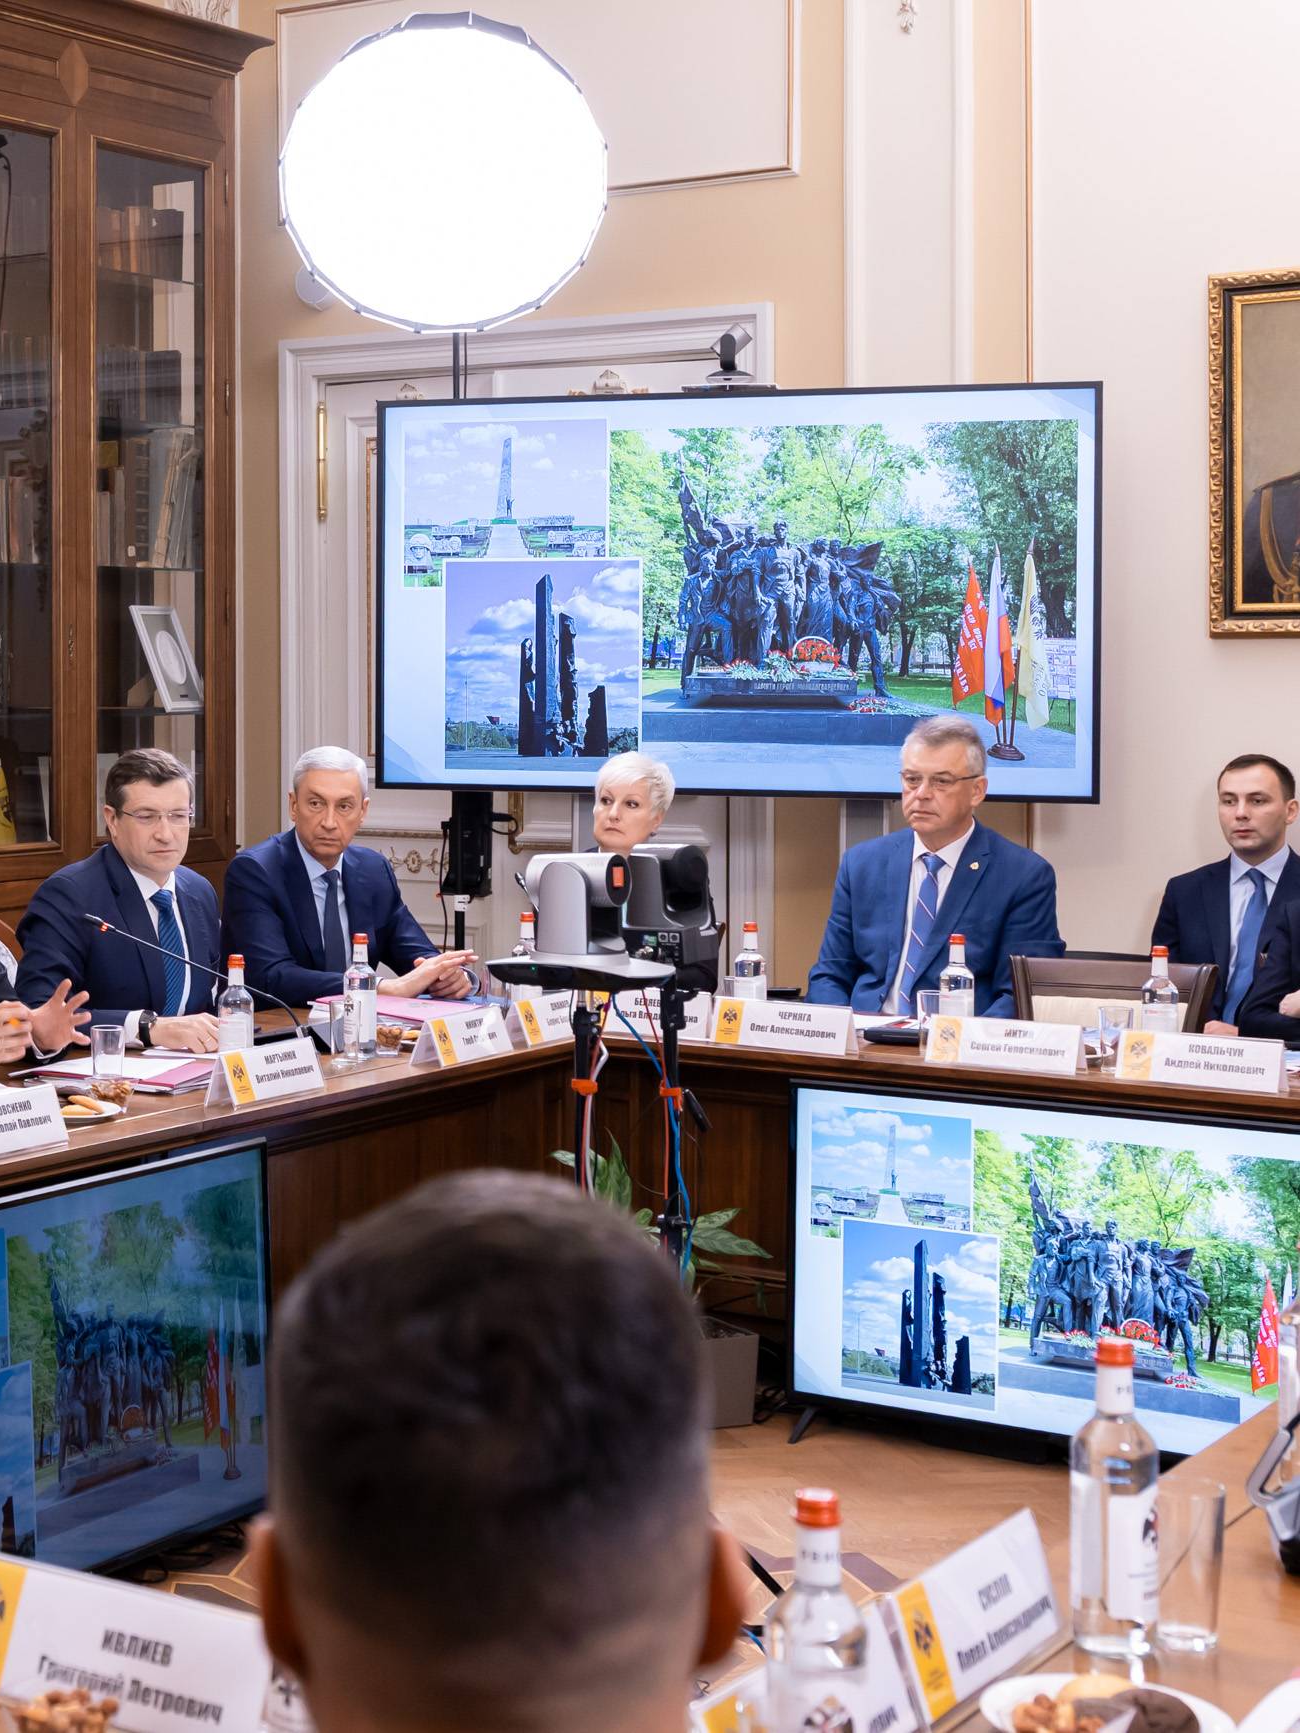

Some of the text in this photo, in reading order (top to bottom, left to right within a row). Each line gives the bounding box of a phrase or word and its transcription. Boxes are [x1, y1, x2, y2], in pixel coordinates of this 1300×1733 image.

[616, 1010, 637, 1019] льга
[778, 1011, 812, 1022] ЧЕРНЯГА
[750, 1023, 769, 1033] Олег
[769, 1024, 836, 1040] Александрович
[1188, 1044, 1244, 1057] КОВАЛЬЧУК
[1164, 1057, 1266, 1076] Андрей Николаевич
[255, 1070, 280, 1084] Виталий
[18, 1113, 52, 1130] Павлович
[101, 1629, 174, 1667] ИВЛИЕВ
[37, 1653, 224, 1725] Григорий Петрович
